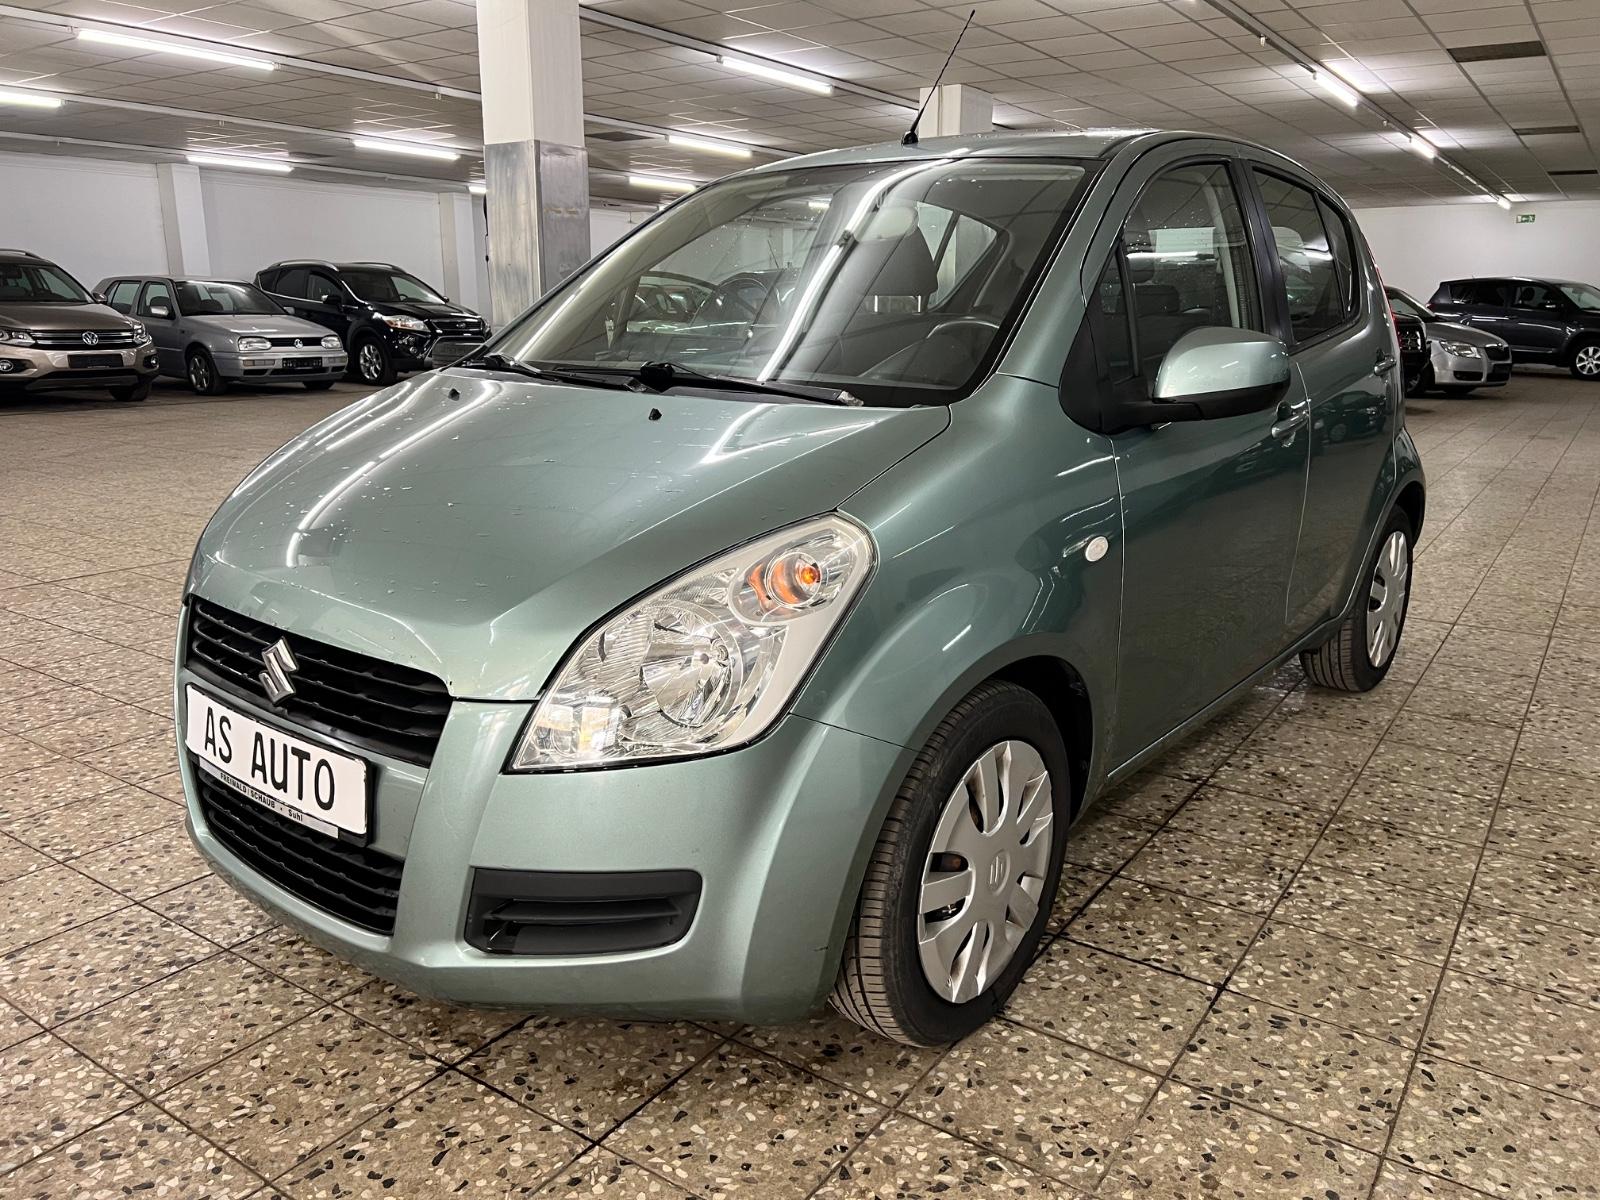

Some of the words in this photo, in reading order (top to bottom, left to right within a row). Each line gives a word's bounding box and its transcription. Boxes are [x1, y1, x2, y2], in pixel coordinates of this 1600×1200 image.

[204, 706, 232, 764] AS
[251, 731, 335, 811] AUTO
[250, 790, 275, 809] SCHAUB
[288, 809, 303, 822] Suhl
